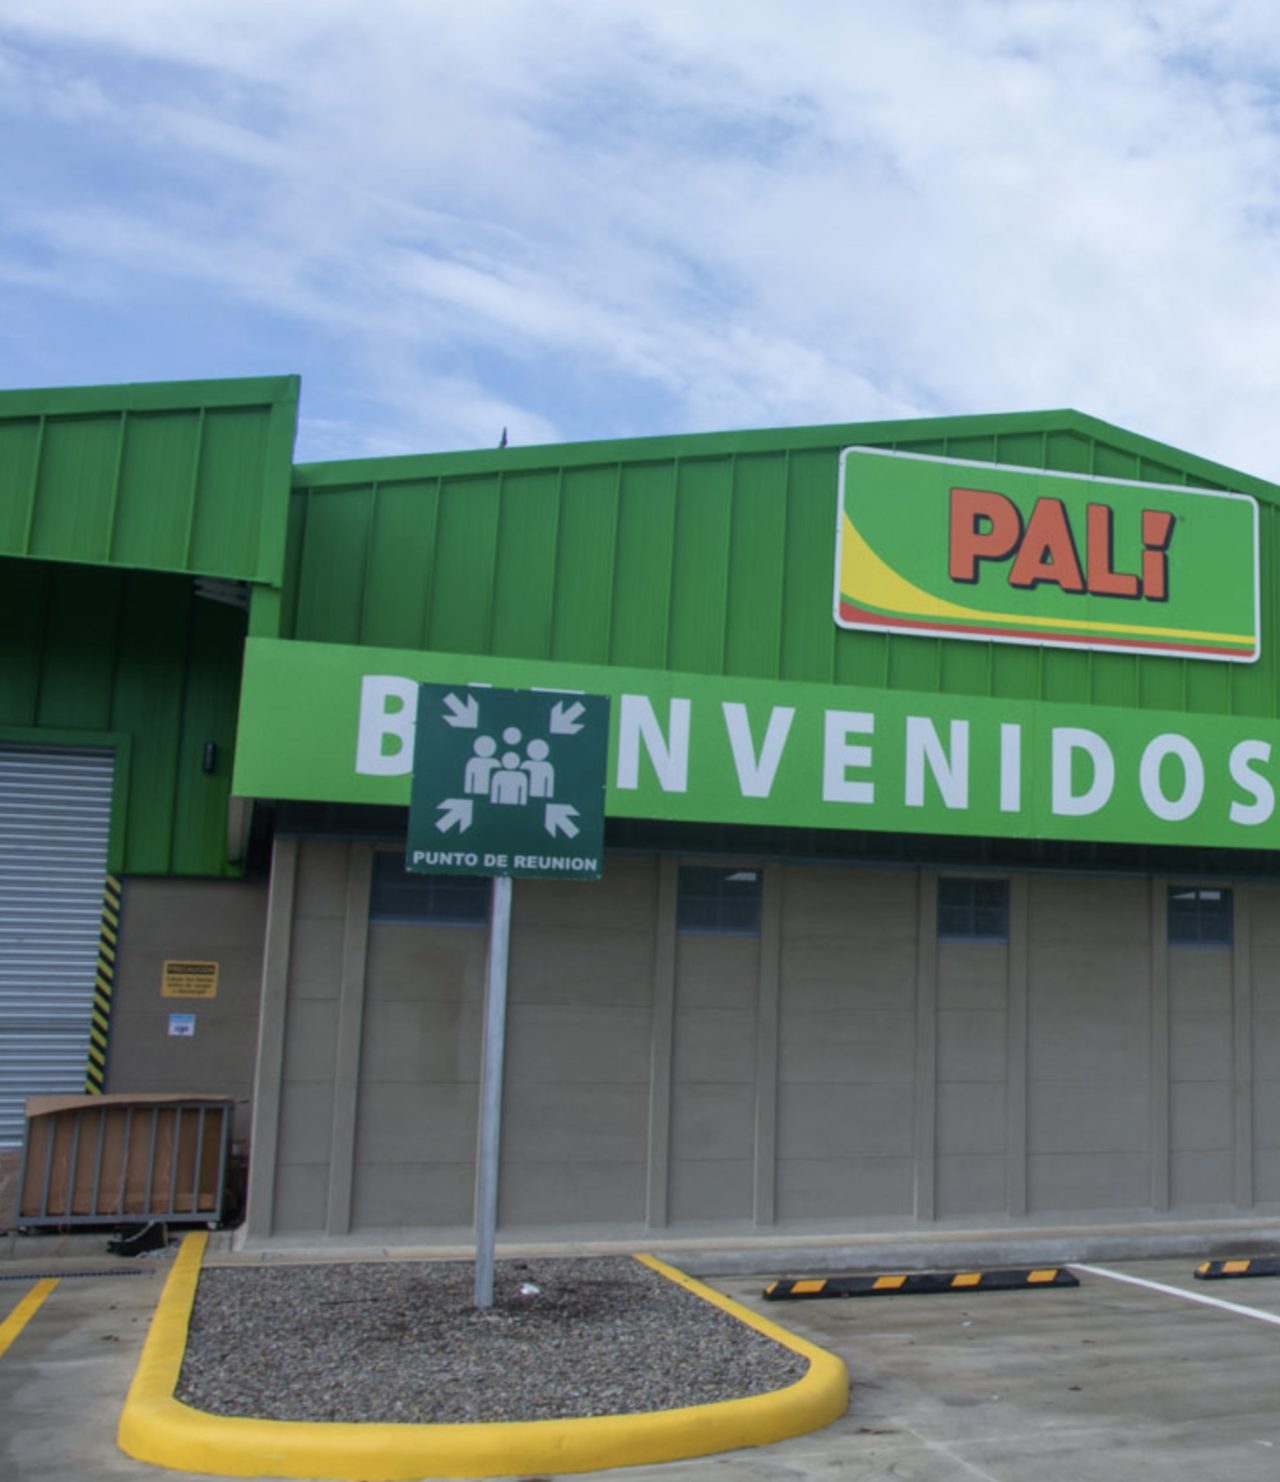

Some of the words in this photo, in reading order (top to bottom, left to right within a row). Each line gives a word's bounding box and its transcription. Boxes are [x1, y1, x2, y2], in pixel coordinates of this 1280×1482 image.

[355, 675, 1275, 825] BNVENIDOS
[413, 850, 477, 867] PUNTO
[484, 854, 508, 868] DE
[514, 855, 597, 871] REUNION
